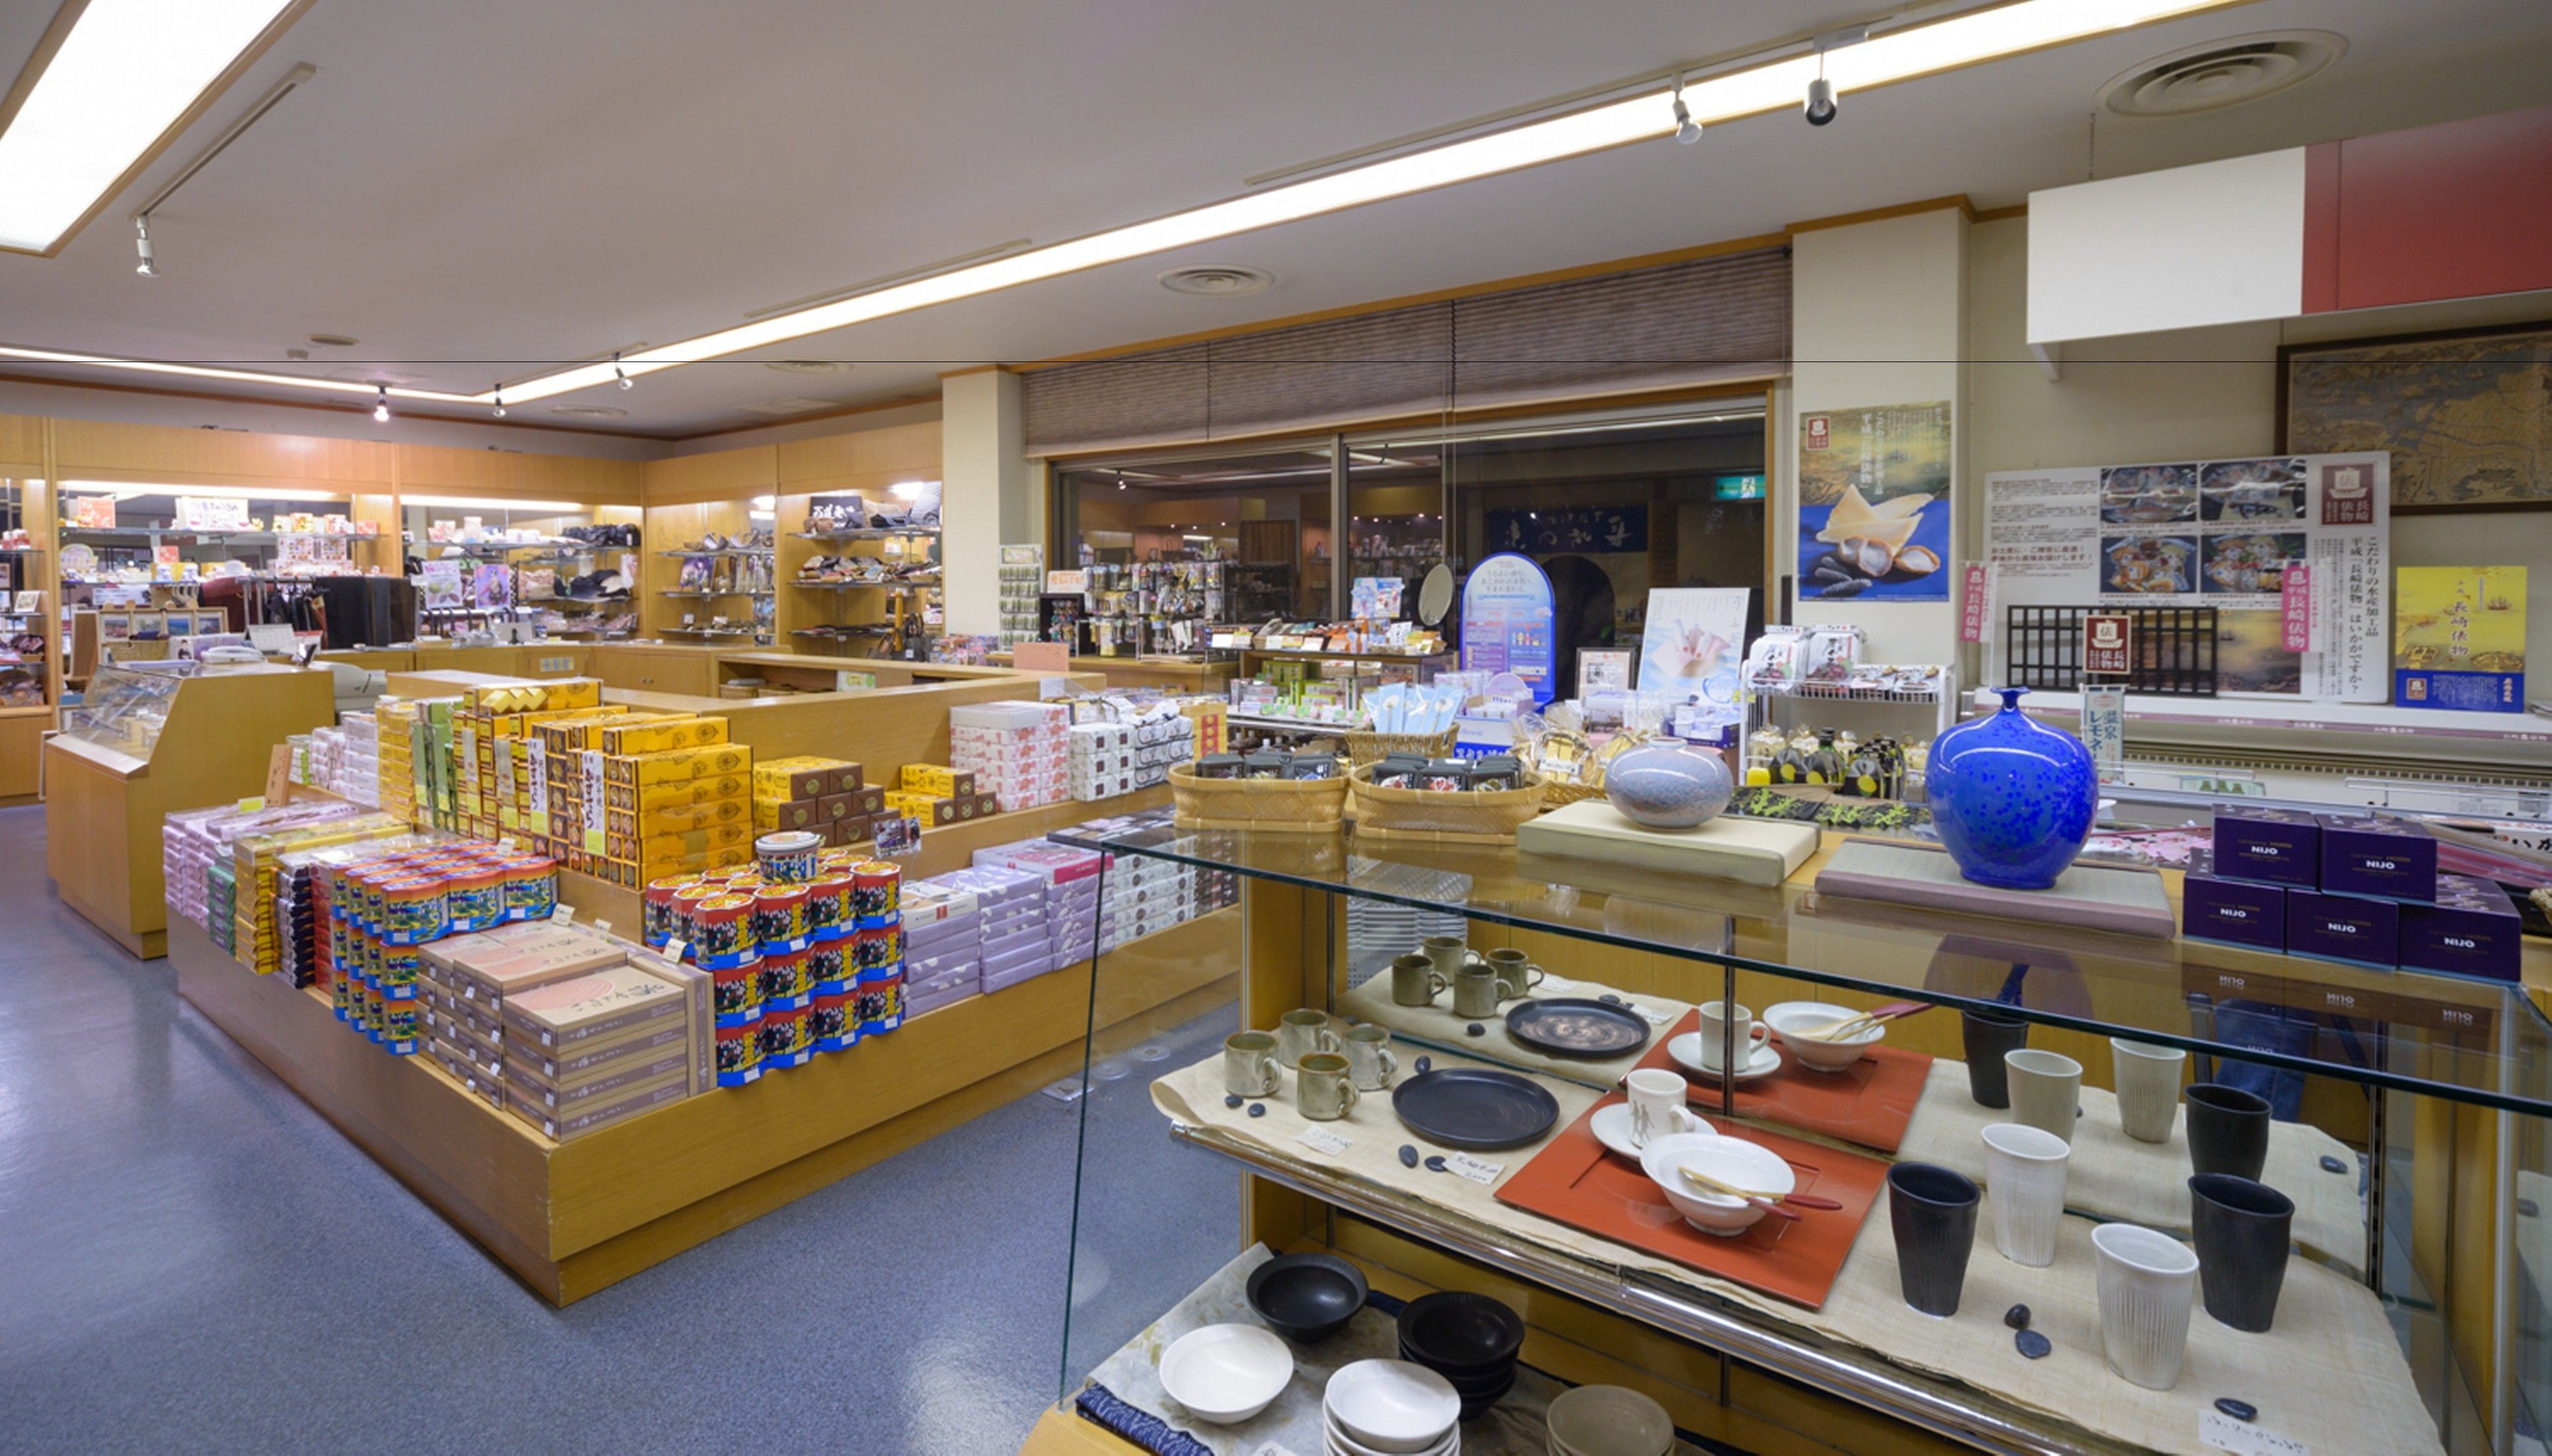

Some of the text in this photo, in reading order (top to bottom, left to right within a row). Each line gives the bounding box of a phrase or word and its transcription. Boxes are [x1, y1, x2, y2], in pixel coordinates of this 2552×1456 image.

[2365, 537, 2379, 637] こだわりの水産加工品
[2287, 595, 2306, 649] 長崎俵物
[2450, 601, 2469, 656] 長崎俵物
[2251, 845, 2278, 855] NIJO
[2365, 860, 2395, 870] NIJO
[2220, 907, 2246, 918] NIJO
[2327, 922, 2357, 934] NIJO
[2444, 936, 2476, 949] NIJO
